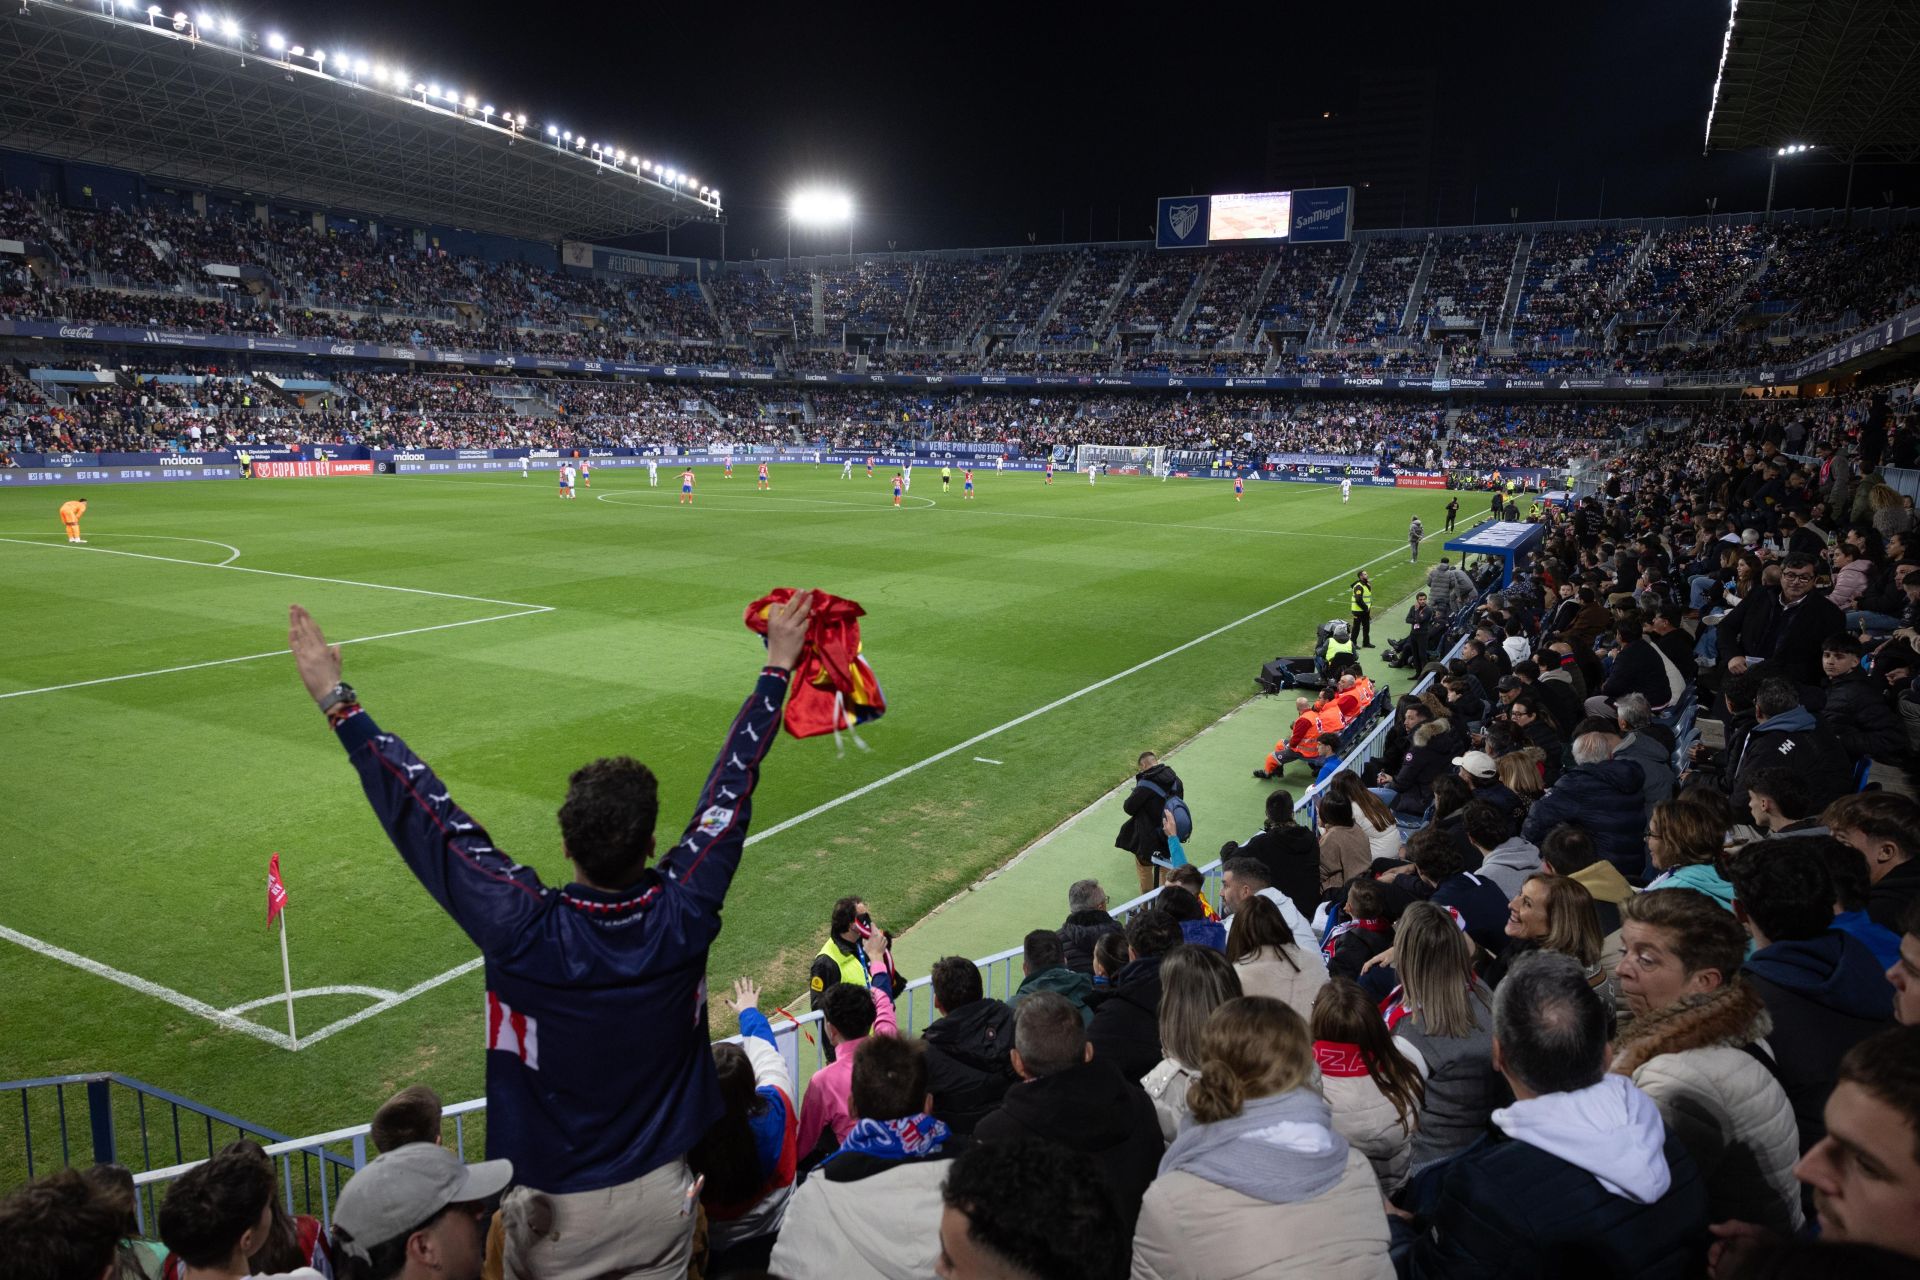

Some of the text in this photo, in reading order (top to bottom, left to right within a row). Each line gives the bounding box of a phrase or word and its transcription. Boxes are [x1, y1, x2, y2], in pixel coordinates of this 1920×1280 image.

[929, 441, 1005, 453] VENCE POR NOSOTROS
[272, 461, 330, 477] COPA DEL REY
[335, 464, 371, 472] MAPFRE
[1778, 739, 1796, 755] HH
